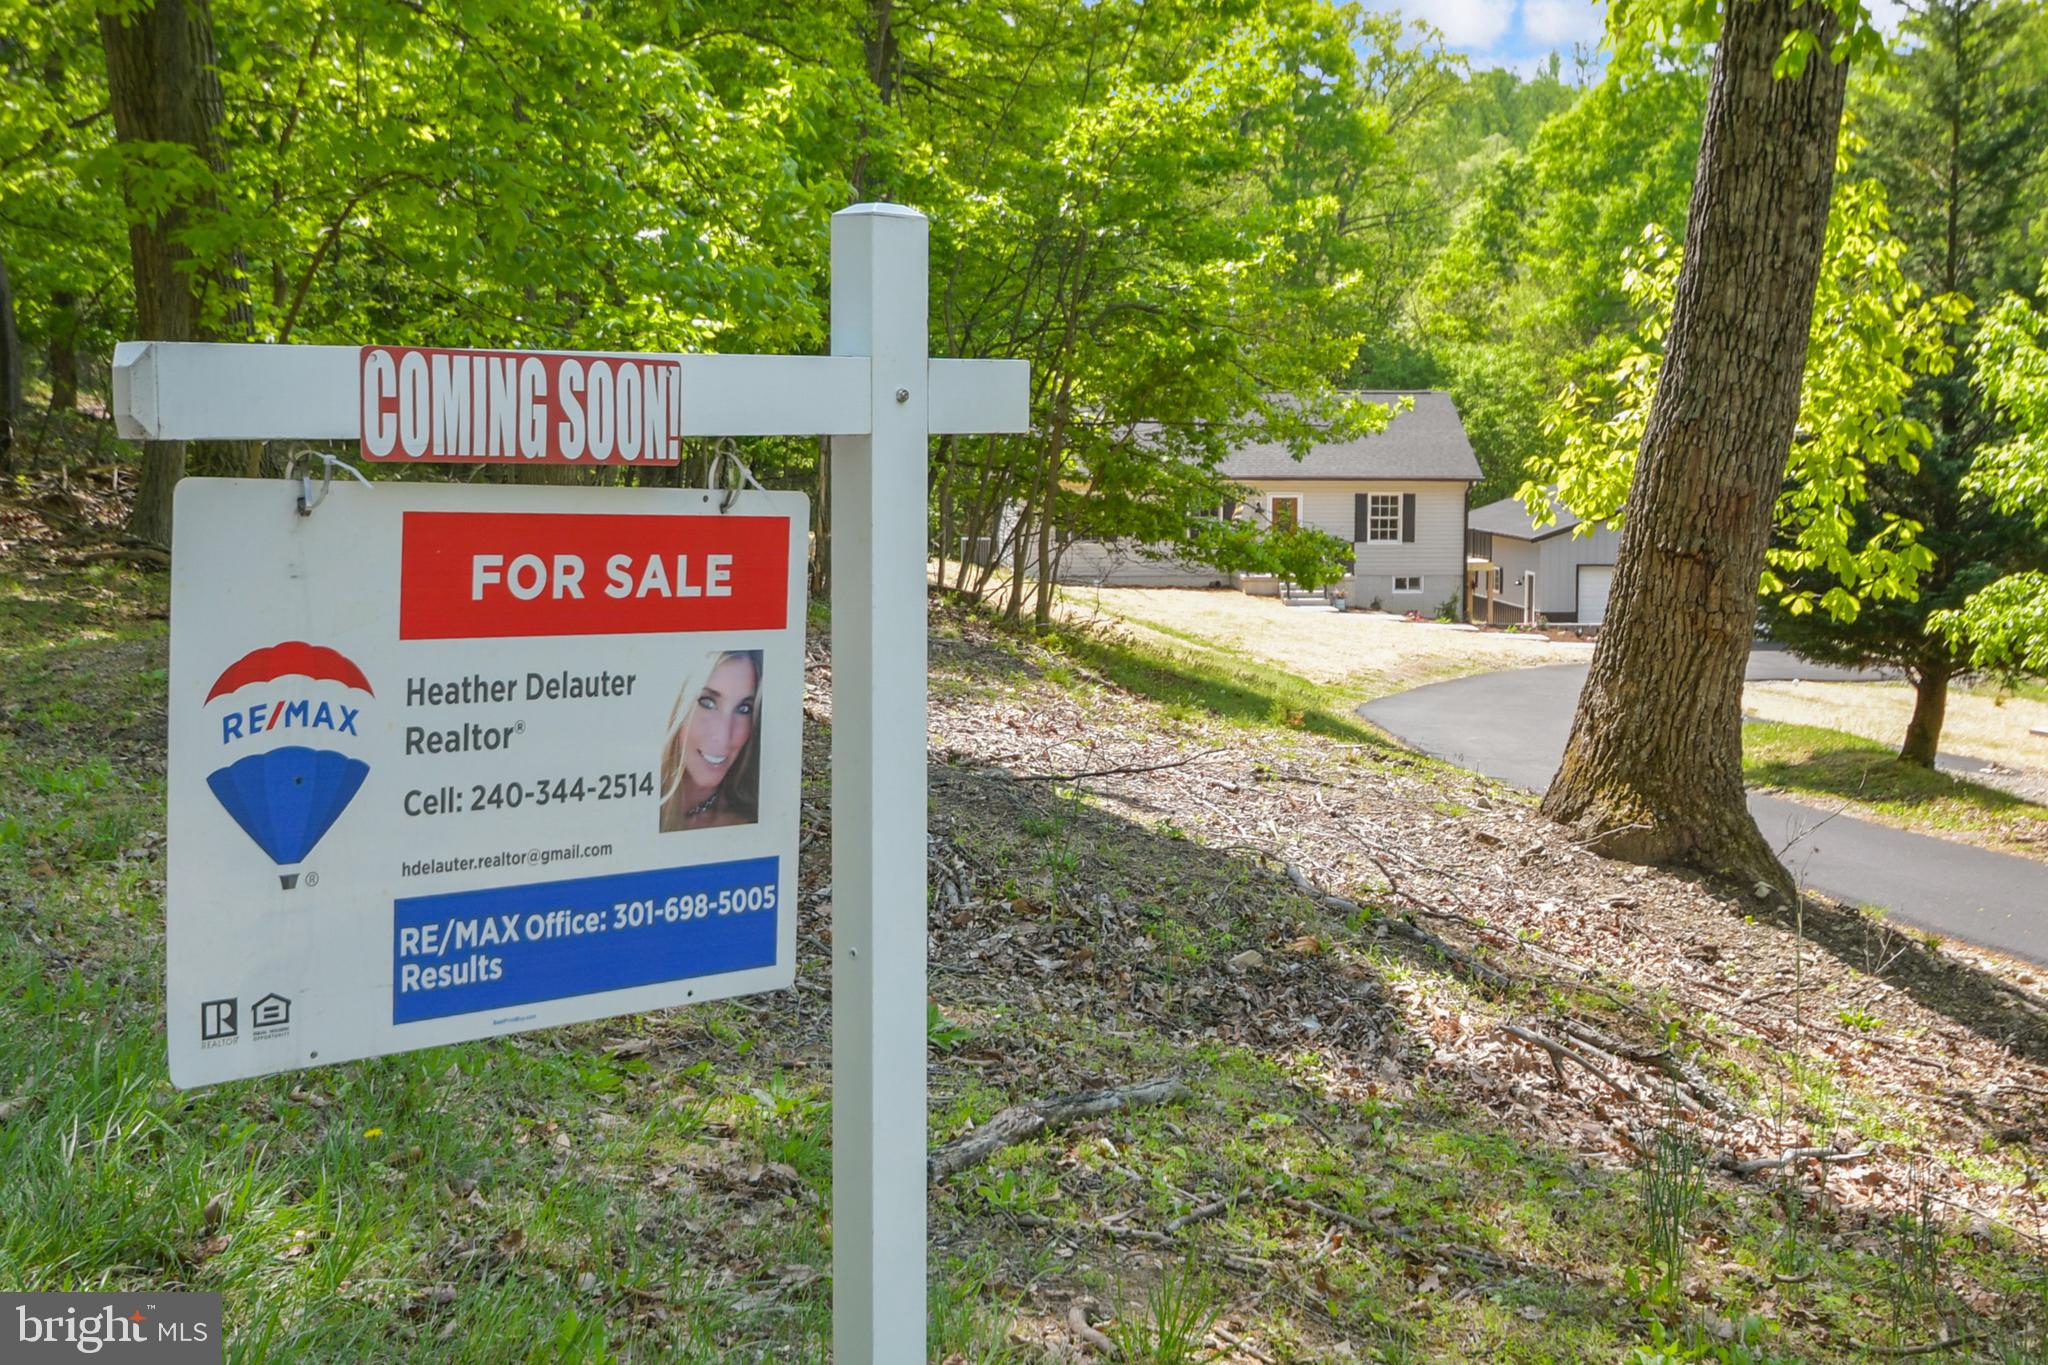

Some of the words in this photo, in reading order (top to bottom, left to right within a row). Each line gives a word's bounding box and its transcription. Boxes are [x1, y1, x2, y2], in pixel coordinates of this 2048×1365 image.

[364, 349, 547, 459] COMING
[558, 358, 680, 460] SOON!
[472, 554, 585, 600] FOR
[604, 554, 733, 598] SALE
[406, 674, 517, 706] Heather
[526, 670, 636, 701] Delauter
[223, 700, 359, 744] RE/MAX
[404, 786, 462, 817] Cell:
[471, 772, 654, 812] 240-344-2514
[402, 843, 613, 876] hdelauter.realtor@gmail.com
[400, 914, 520, 957] RE/MAX
[525, 909, 607, 941] Office:
[613, 884, 776, 930] 301-698-5005
[401, 955, 503, 993] Results
